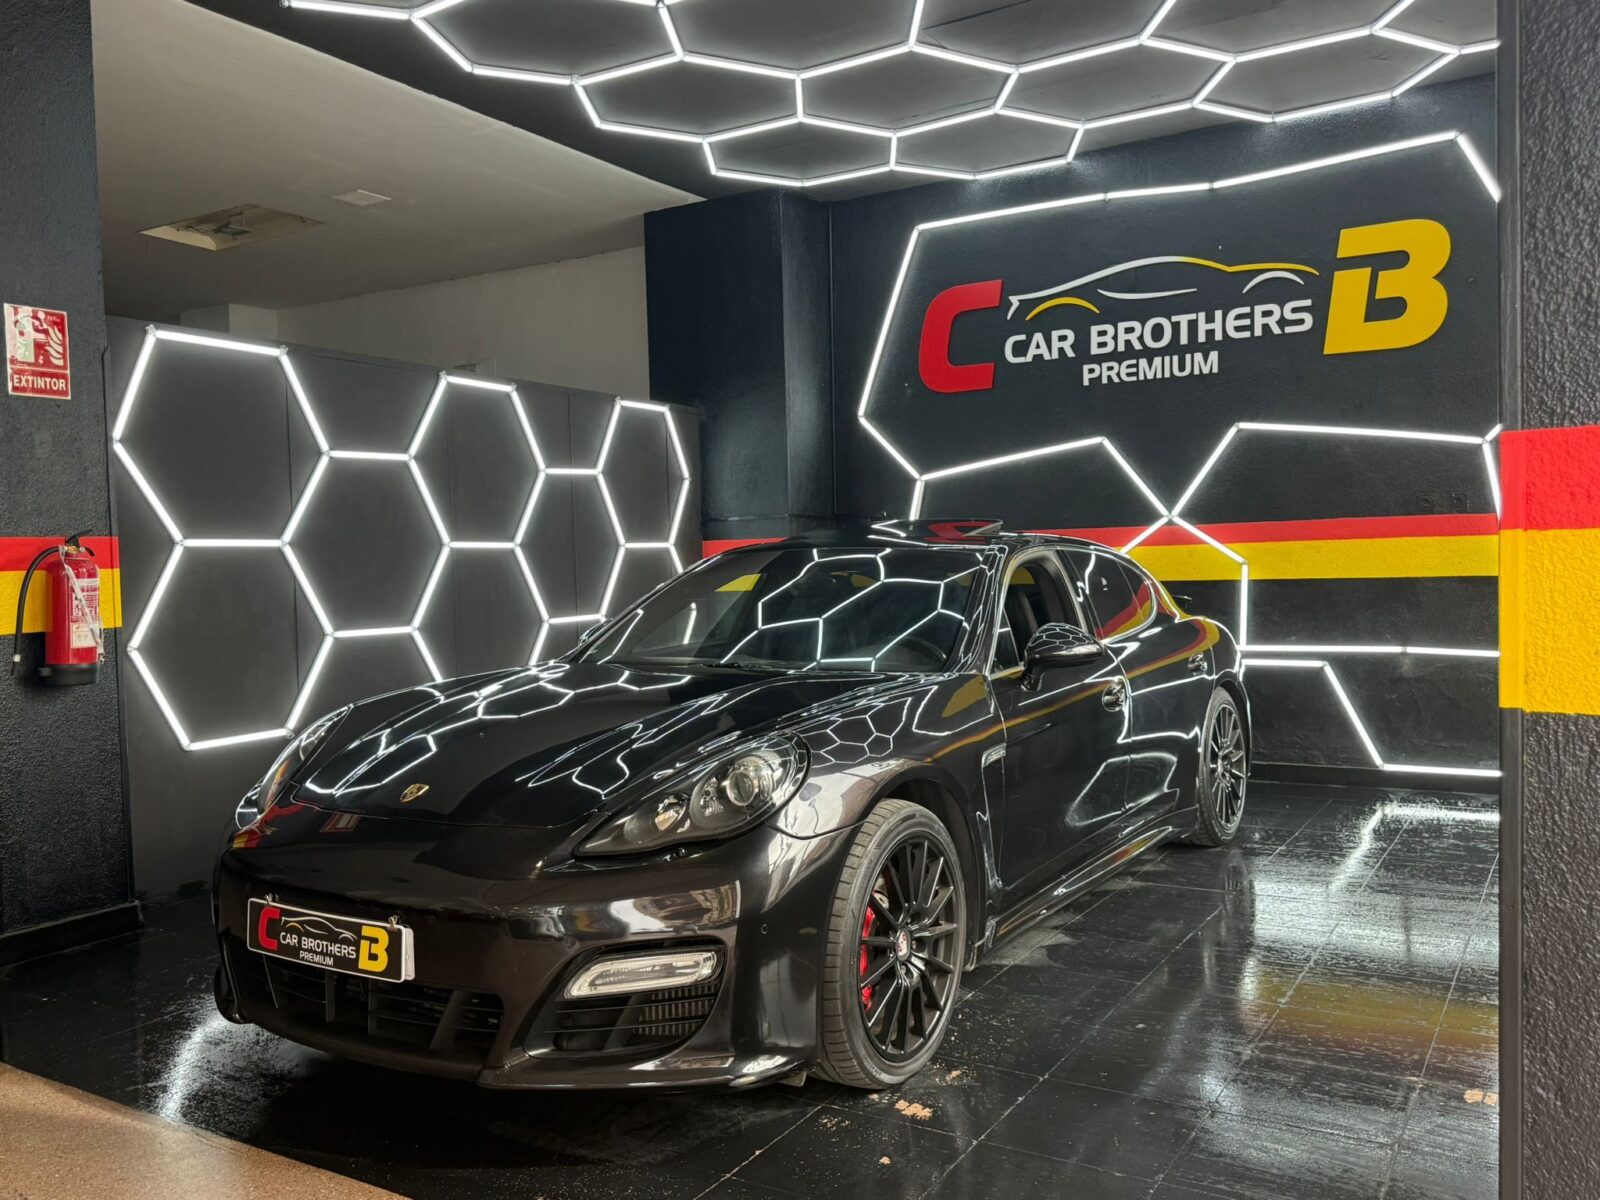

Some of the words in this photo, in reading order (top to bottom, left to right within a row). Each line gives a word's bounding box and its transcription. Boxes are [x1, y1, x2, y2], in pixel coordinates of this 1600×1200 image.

[1323, 218, 1451, 355] B
[919, 279, 1004, 393] C
[1004, 328, 1075, 365] CAR
[1089, 299, 1313, 356] BROTHERS
[13, 375, 66, 391] EXTINTOR
[1082, 350, 1219, 387] PREMIUM
[279, 932, 299, 947] CAR
[301, 936, 357, 959] BROTHERS
[299, 950, 334, 967] PREMIUM
